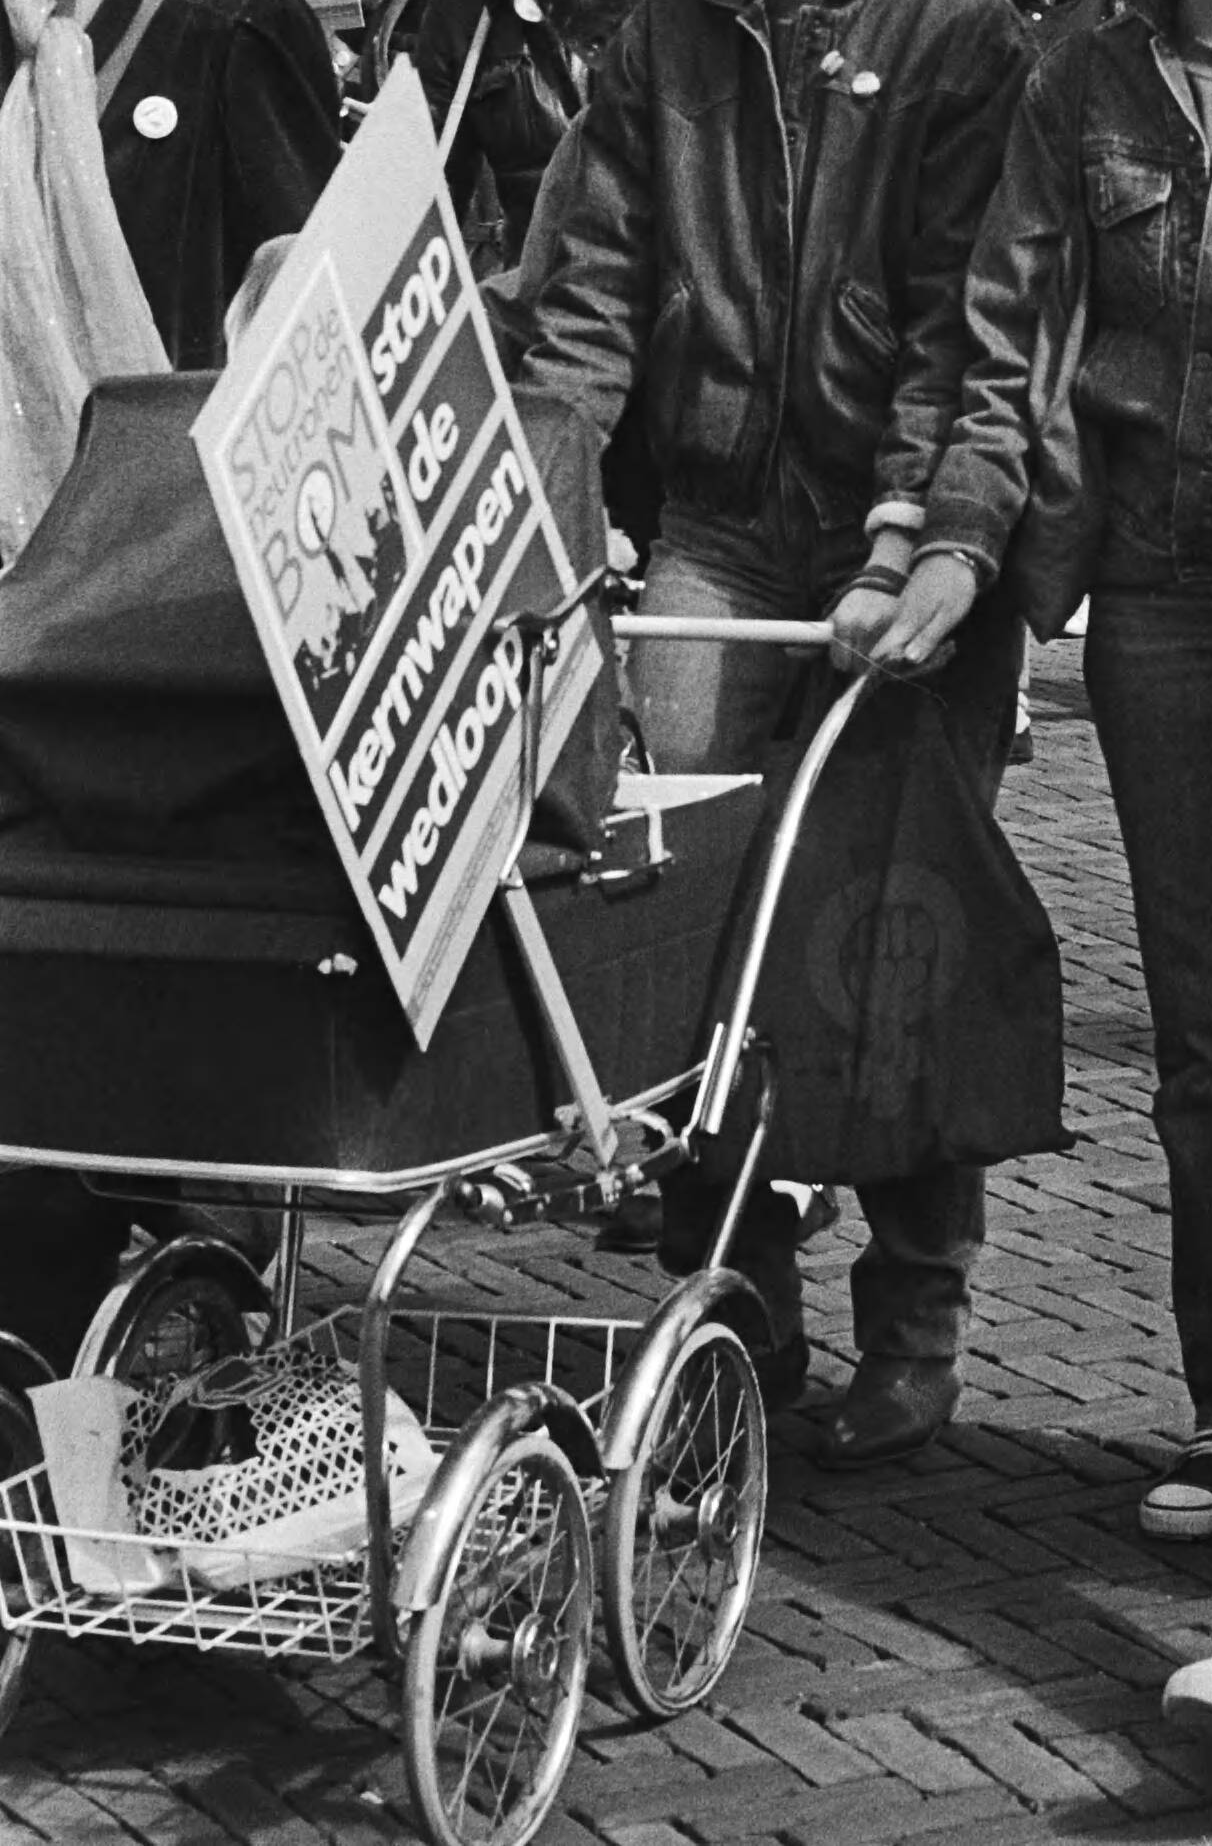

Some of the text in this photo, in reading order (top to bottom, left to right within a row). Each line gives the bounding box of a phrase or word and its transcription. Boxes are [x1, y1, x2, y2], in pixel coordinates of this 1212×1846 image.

[313, 305, 341, 362] de
[371, 236, 451, 395] stop
[230, 321, 311, 506] STOP
[249, 341, 356, 543] neutronen
[263, 376, 380, 627] BOM
[409, 403, 460, 502] de
[329, 450, 525, 833] kernwapen
[378, 625, 524, 920] wedloop
